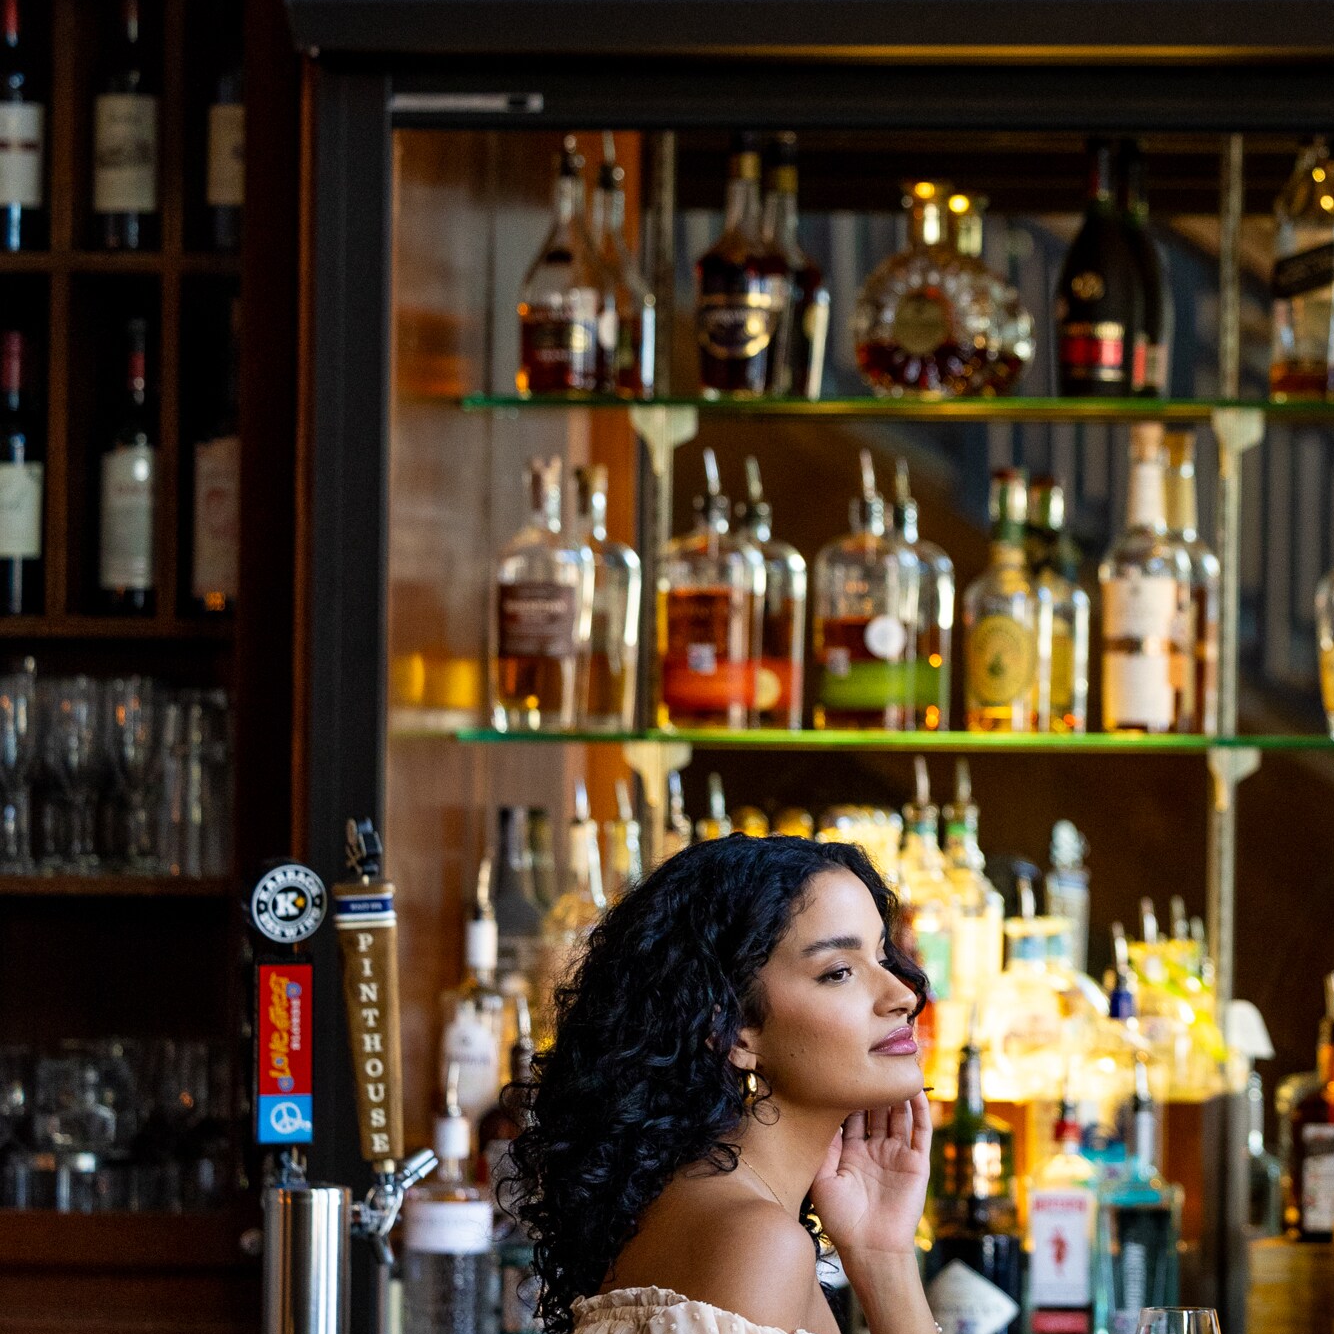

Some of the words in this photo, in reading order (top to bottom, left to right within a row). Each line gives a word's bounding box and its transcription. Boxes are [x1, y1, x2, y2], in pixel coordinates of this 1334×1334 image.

[258, 870, 322, 901] KARBACH
[275, 891, 301, 917] K
[258, 907, 322, 937] BREWING
[356, 932, 390, 1153] PINTHOUSE
